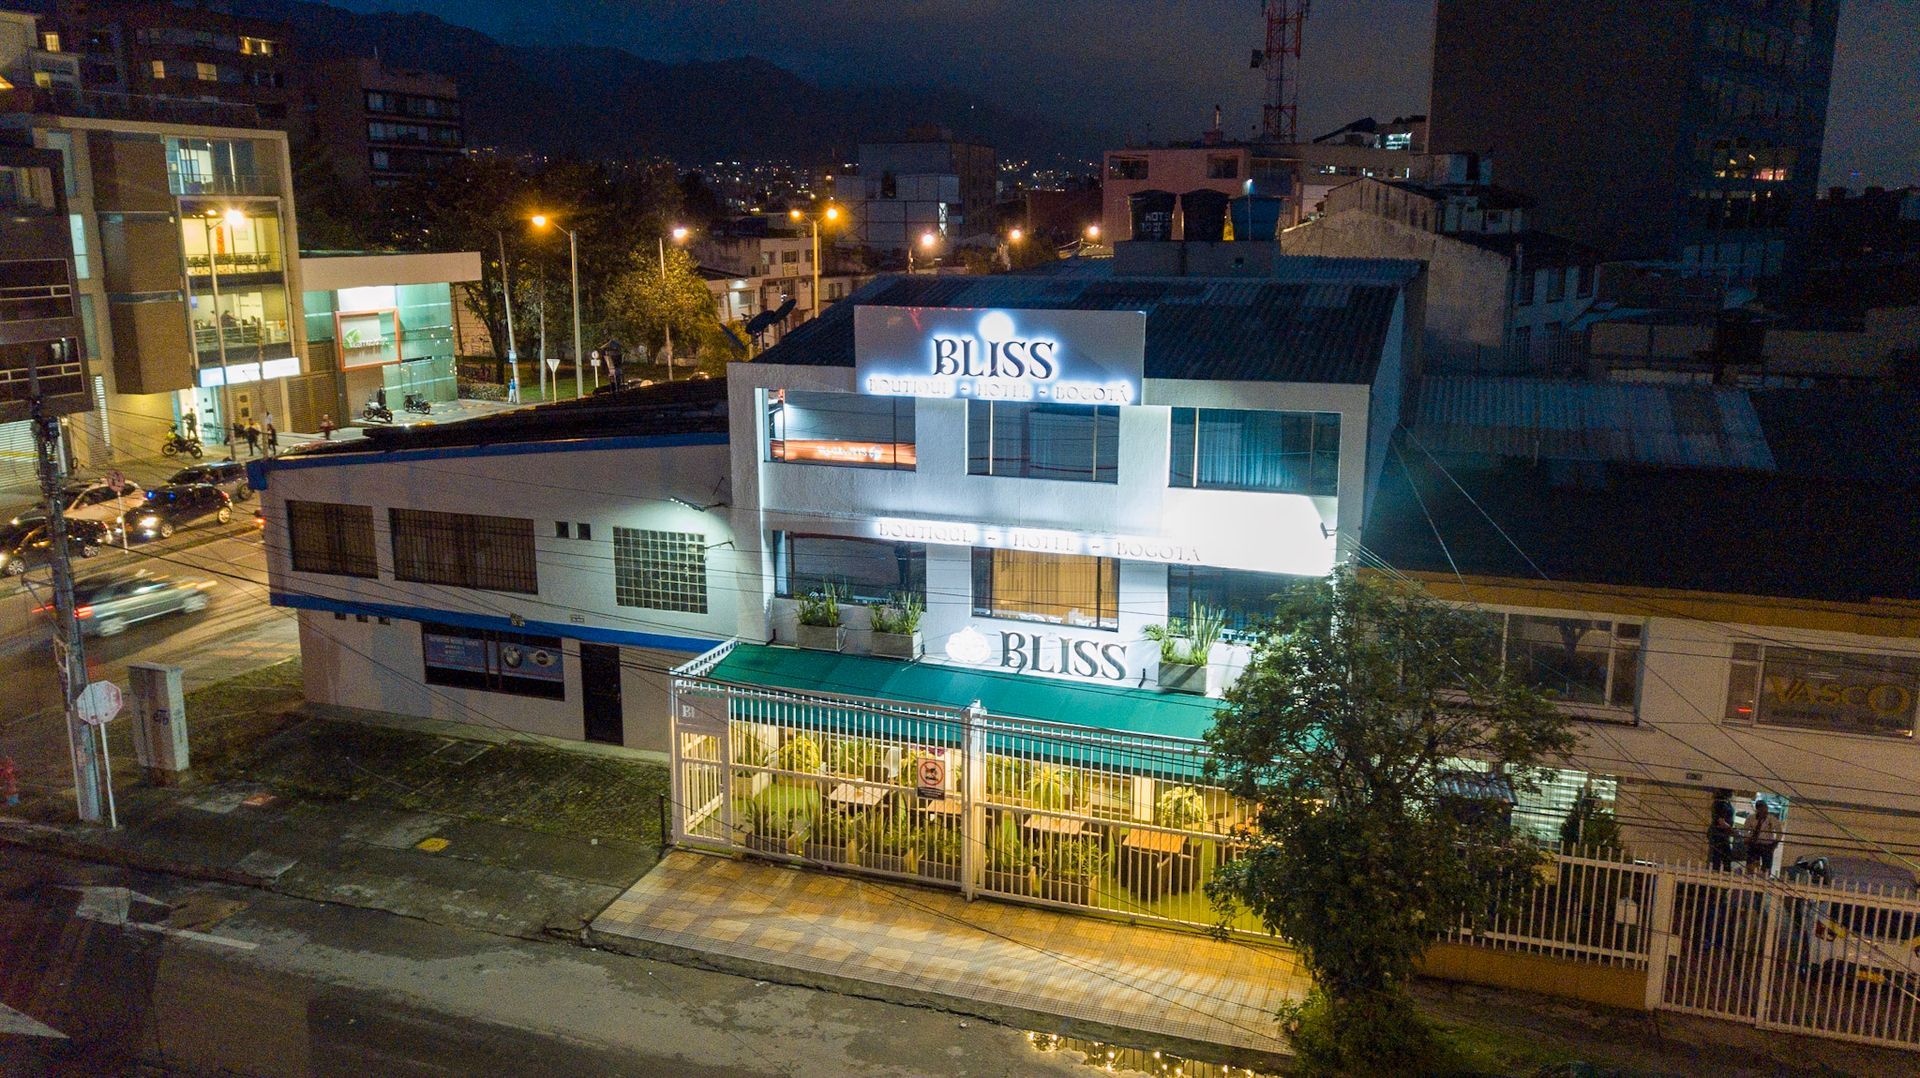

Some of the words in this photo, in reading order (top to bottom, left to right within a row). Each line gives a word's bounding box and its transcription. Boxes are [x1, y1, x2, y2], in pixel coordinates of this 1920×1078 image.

[932, 337, 1054, 379] BLISS
[977, 381, 1030, 399] HOTEL
[1013, 531, 1075, 552] HOTEL
[1000, 630, 1128, 680] BLISS
[1765, 673, 1911, 715] VASCO
